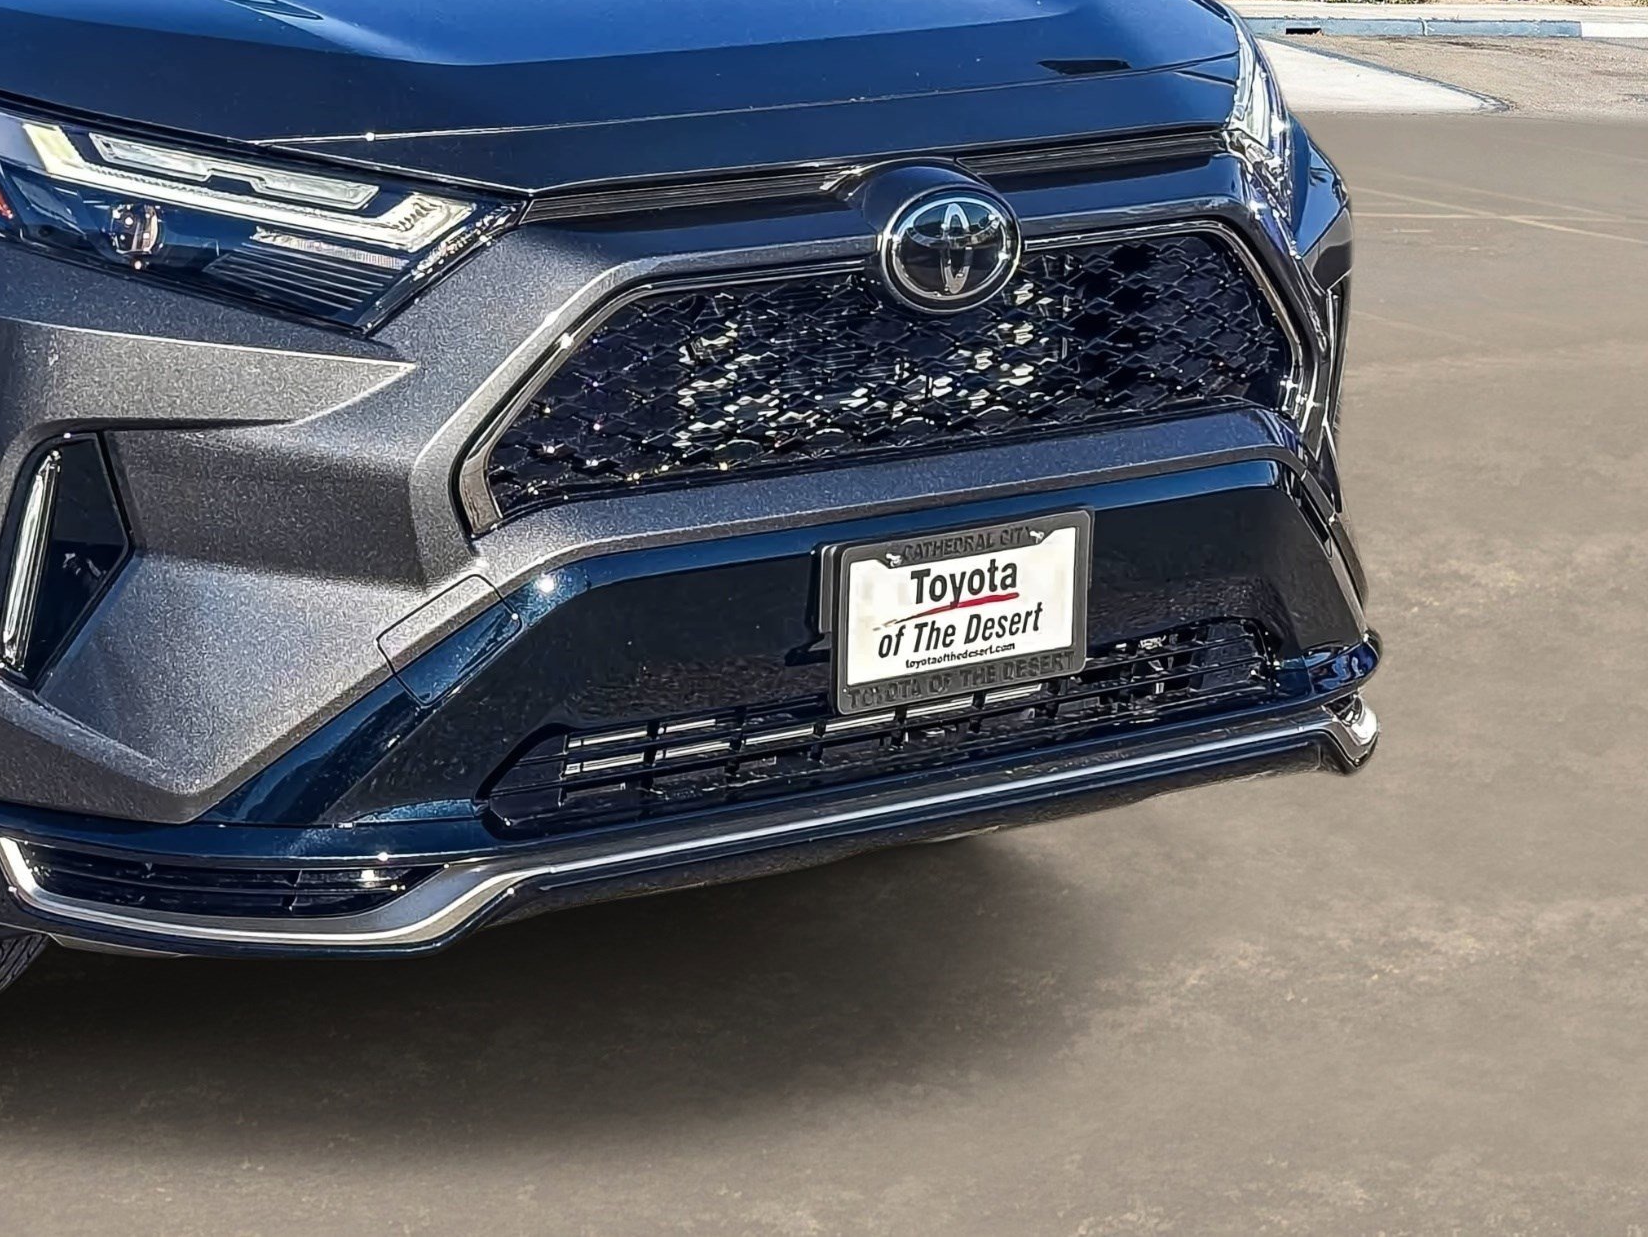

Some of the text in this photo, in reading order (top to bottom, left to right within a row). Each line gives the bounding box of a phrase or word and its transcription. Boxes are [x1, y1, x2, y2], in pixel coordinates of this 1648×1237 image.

[902, 533, 994, 562] CATHEDRAL
[910, 558, 1019, 608] Toyota
[878, 602, 1044, 659] of The Desert
[905, 642, 1016, 669] toyotaofthedesert.com
[960, 665, 997, 688] THE
[1003, 651, 1075, 681] DESERT
